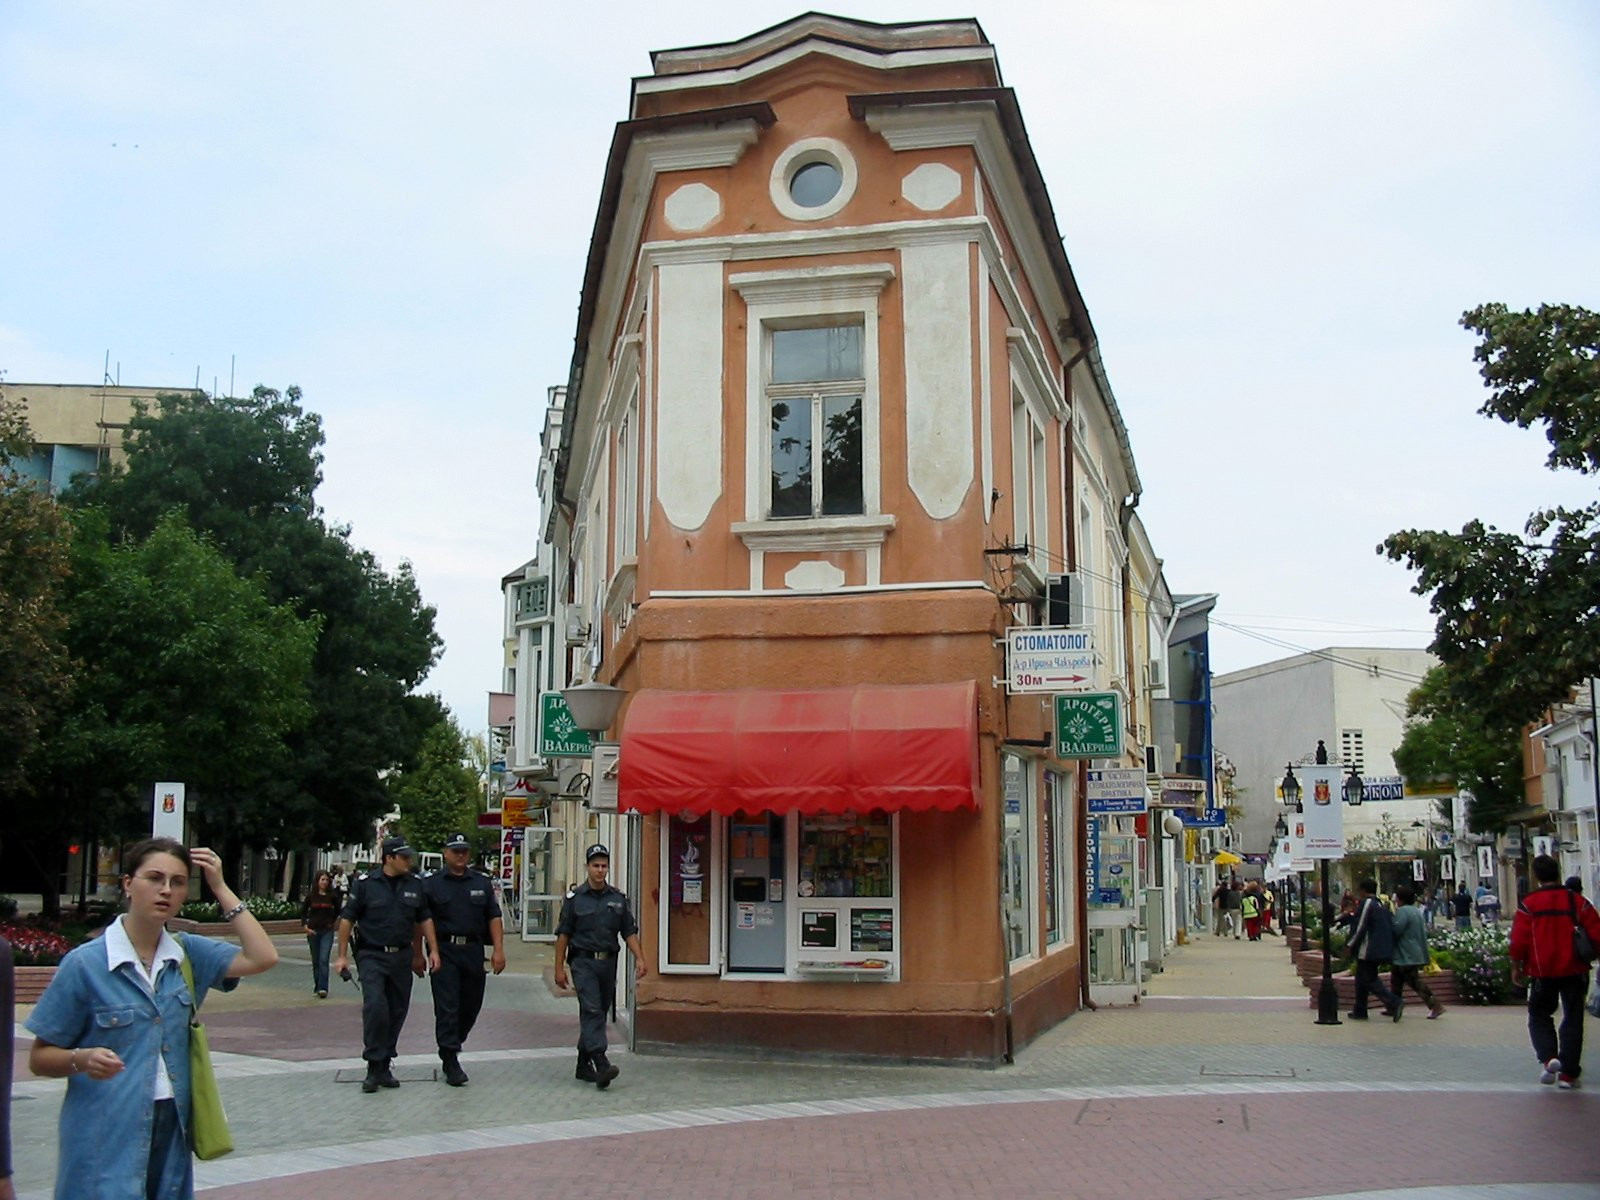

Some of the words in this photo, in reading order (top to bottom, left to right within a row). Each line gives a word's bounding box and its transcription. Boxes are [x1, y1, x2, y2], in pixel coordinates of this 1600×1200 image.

[1015, 634, 1088, 651] СТОМАТОЛОГ
[1016, 674, 1042, 686] 30м
[1063, 699, 1115, 743] ДРОГЕРИЯ
[1086, 823, 1096, 899] СТОМАТОЛОГ
